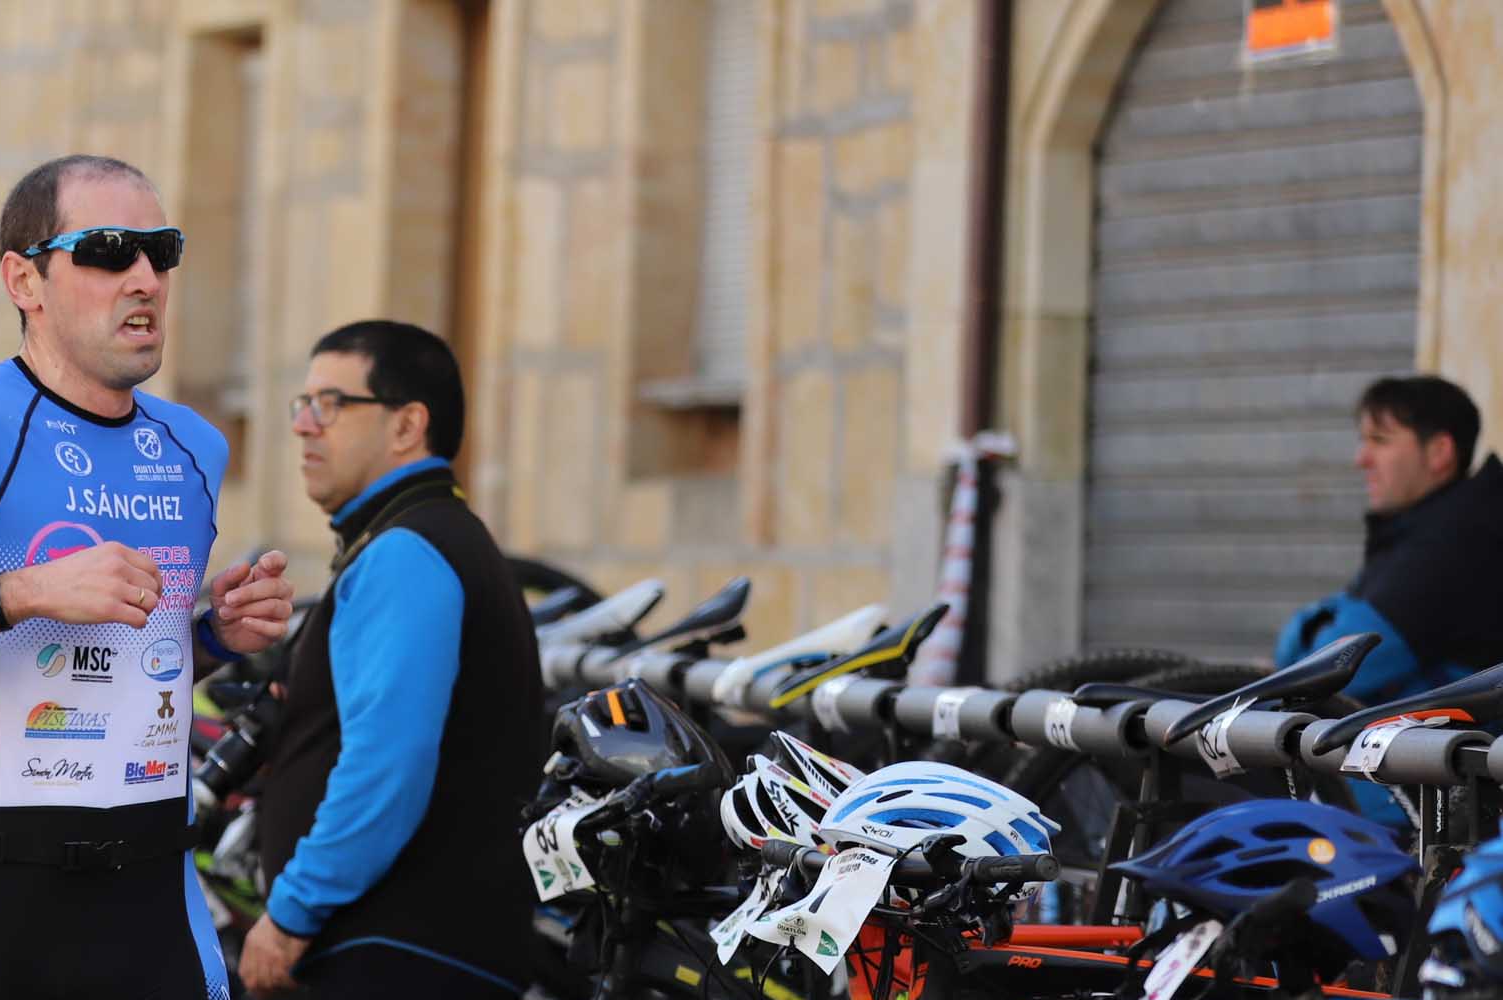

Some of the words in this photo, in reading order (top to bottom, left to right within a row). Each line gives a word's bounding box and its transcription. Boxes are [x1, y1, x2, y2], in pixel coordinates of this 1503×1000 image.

[66, 484, 183, 521] J.SÁNCHEZ
[73, 646, 111, 672] MSC
[33, 711, 110, 727] PISCINAS
[1008, 955, 1042, 969] PRO
